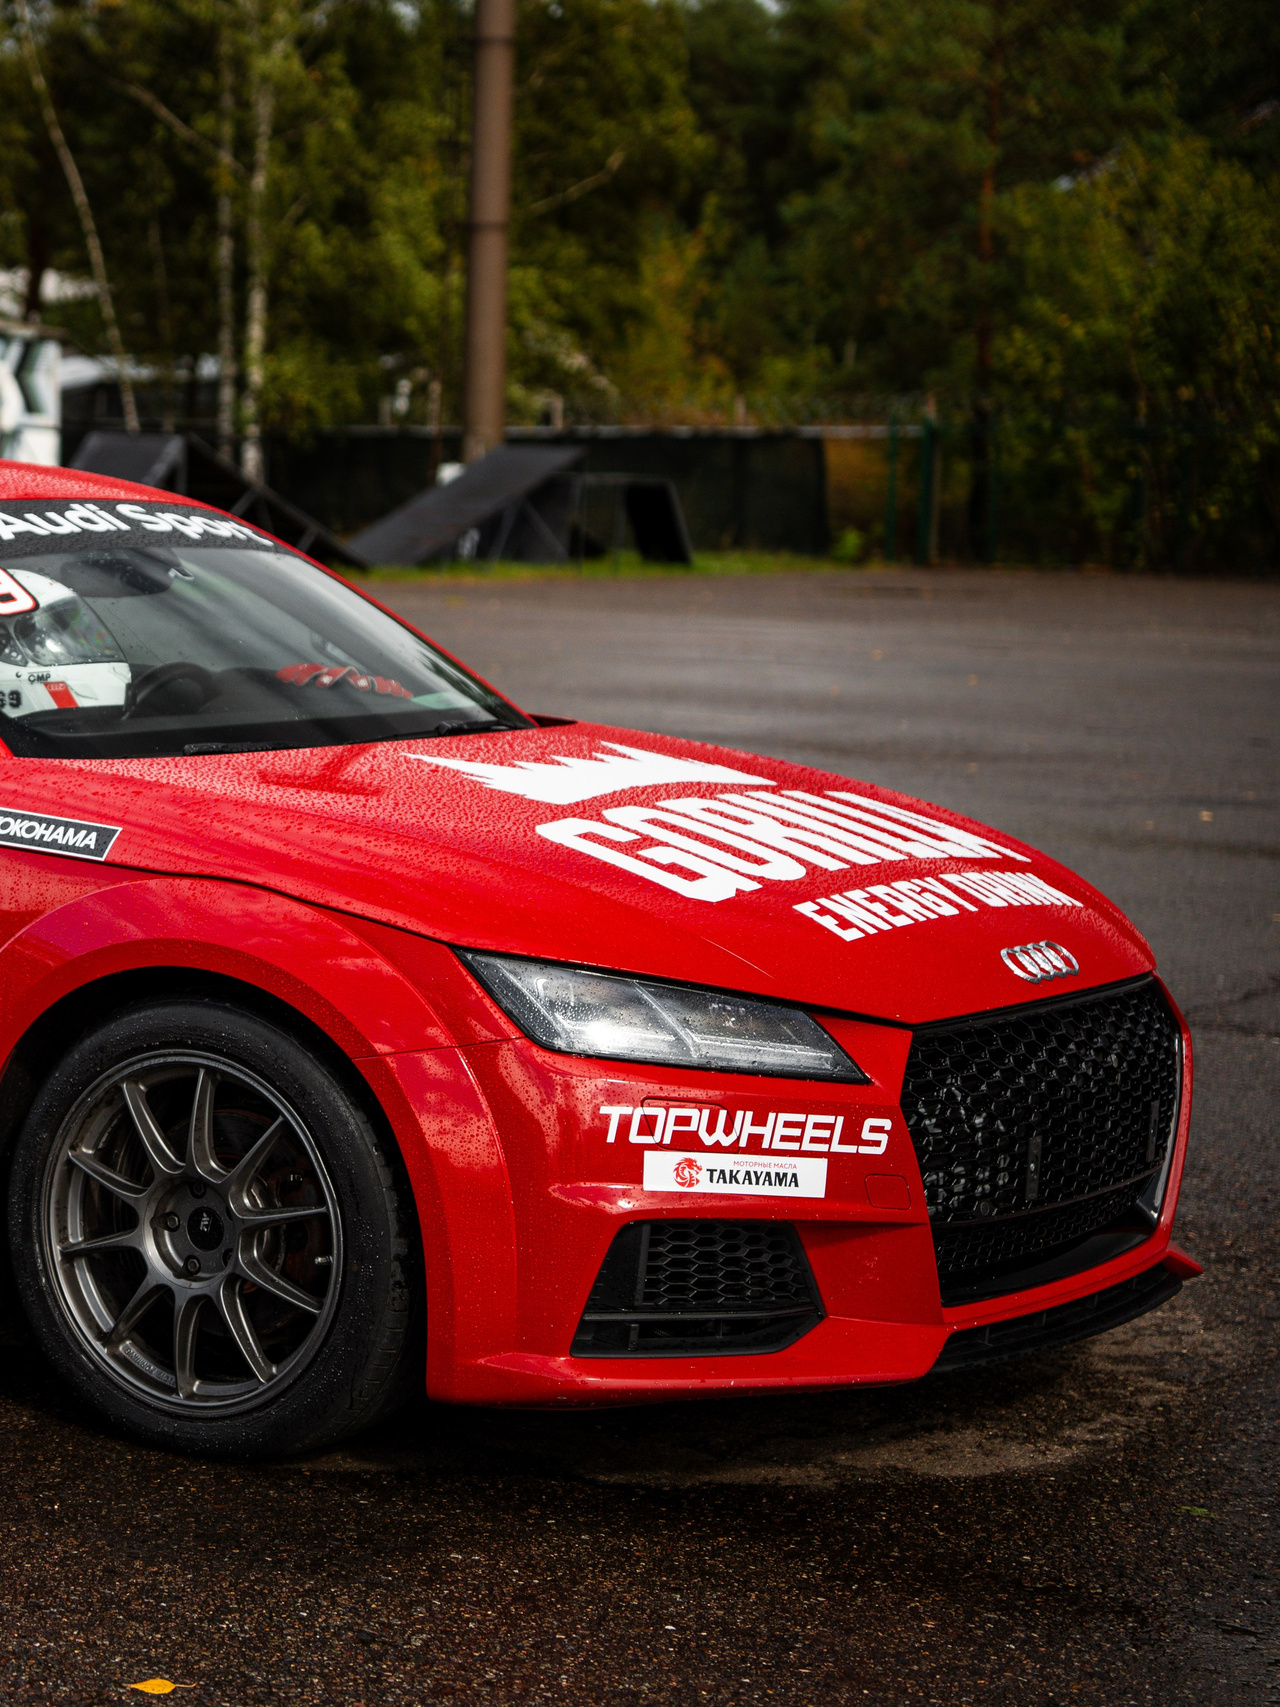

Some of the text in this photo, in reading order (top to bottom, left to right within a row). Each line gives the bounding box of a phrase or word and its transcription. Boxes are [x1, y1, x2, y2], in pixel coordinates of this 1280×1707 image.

[116, 503, 274, 547] Sport
[535, 790, 1031, 902] GORILLA
[792, 872, 1084, 942] ENERGY DRINK
[599, 1105, 892, 1155] TOPWHEELS
[706, 1168, 799, 1188] TAKAYAMA
[733, 1160, 772, 1169] МОТОРНЫЕ
